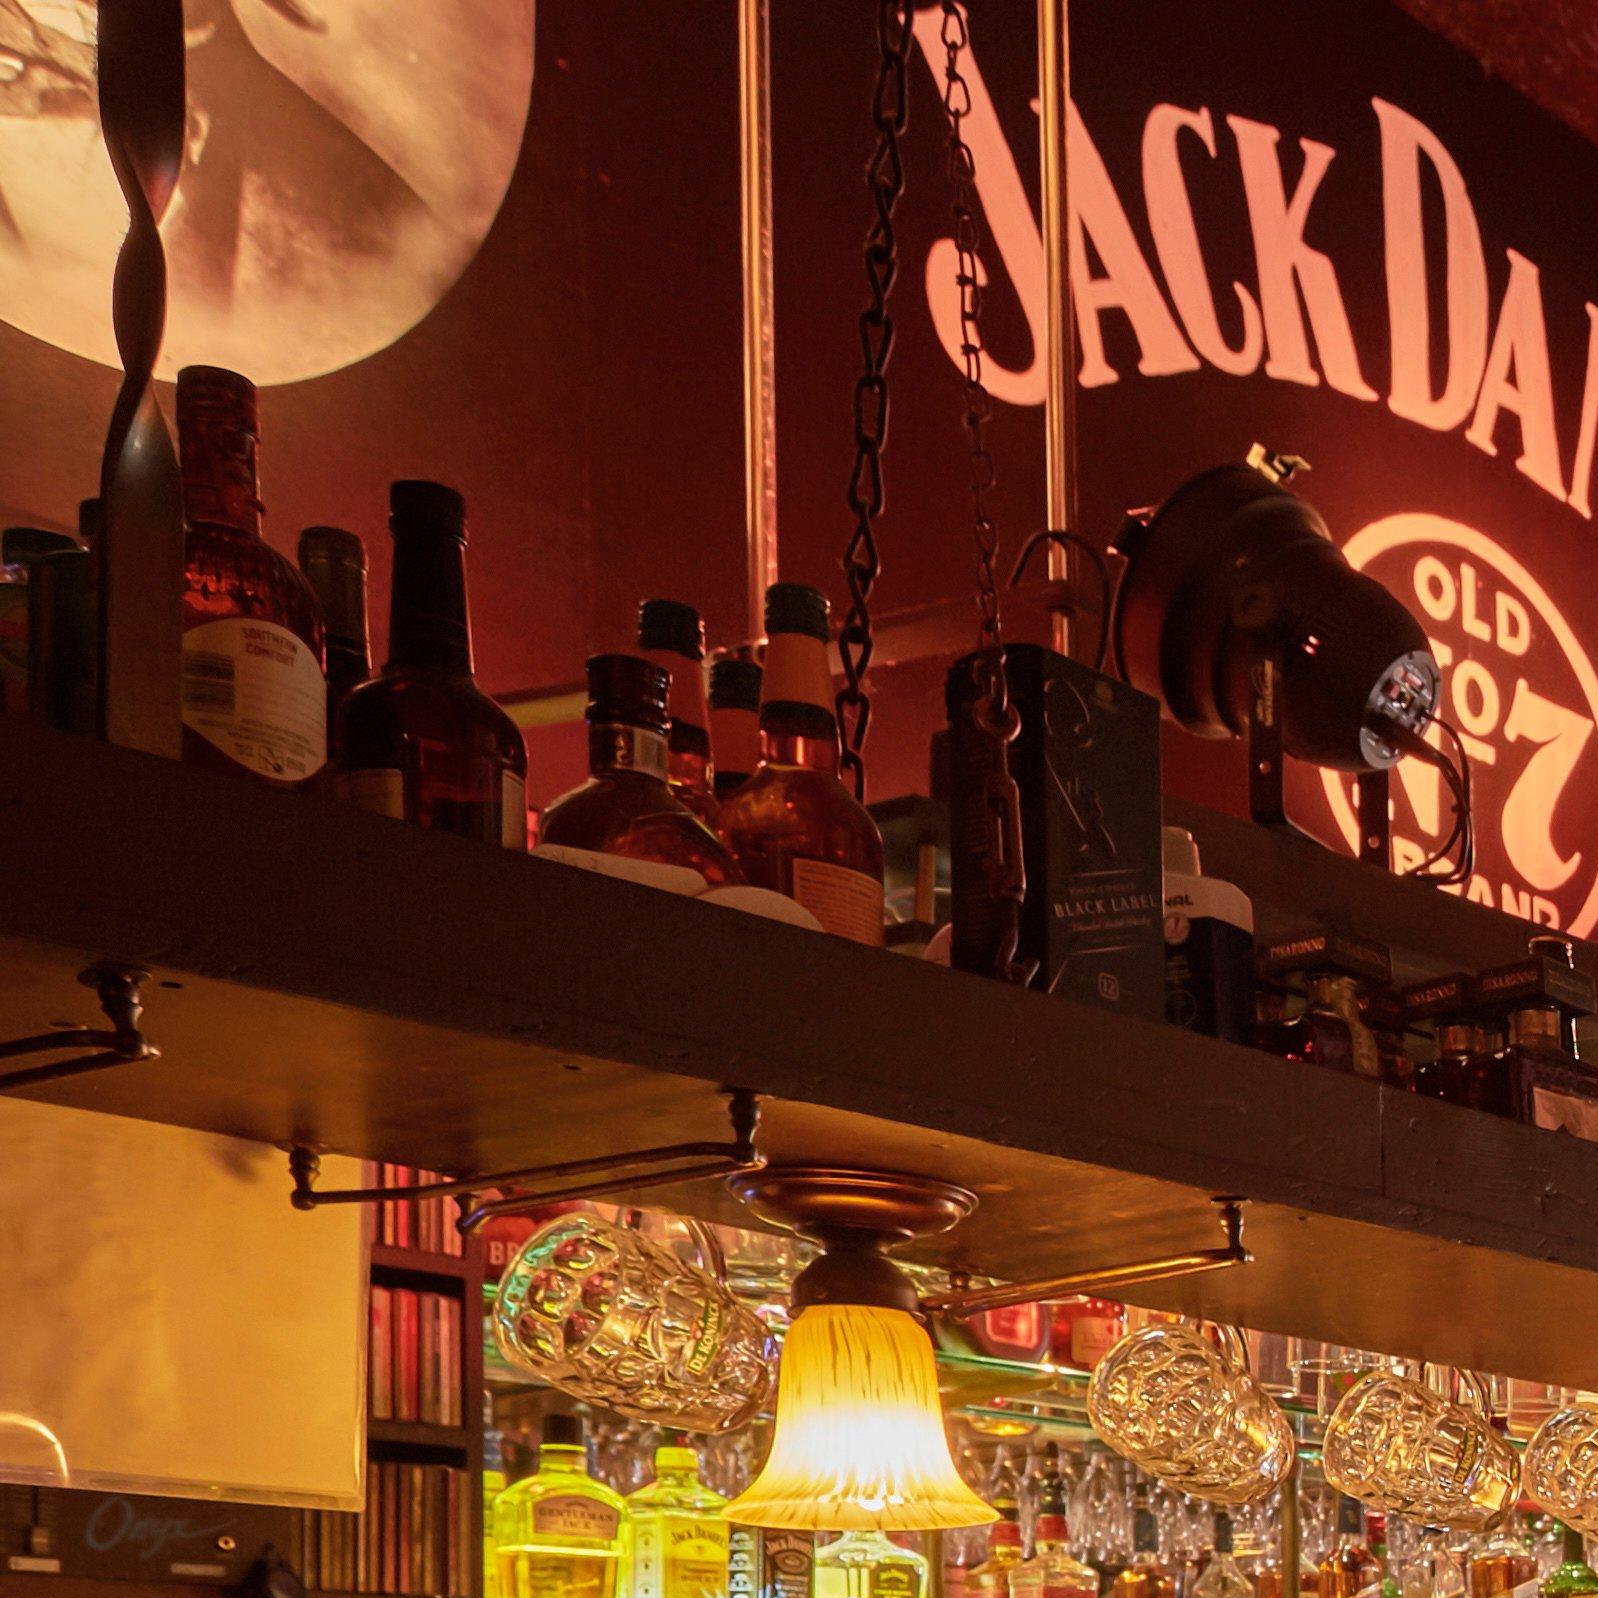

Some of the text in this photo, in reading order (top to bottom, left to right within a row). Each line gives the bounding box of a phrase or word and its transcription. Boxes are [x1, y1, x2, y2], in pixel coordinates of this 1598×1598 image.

[926, 3, 1378, 406] JACK
[1413, 556, 1530, 656] OLD
[1054, 900, 1105, 918] BLACK
